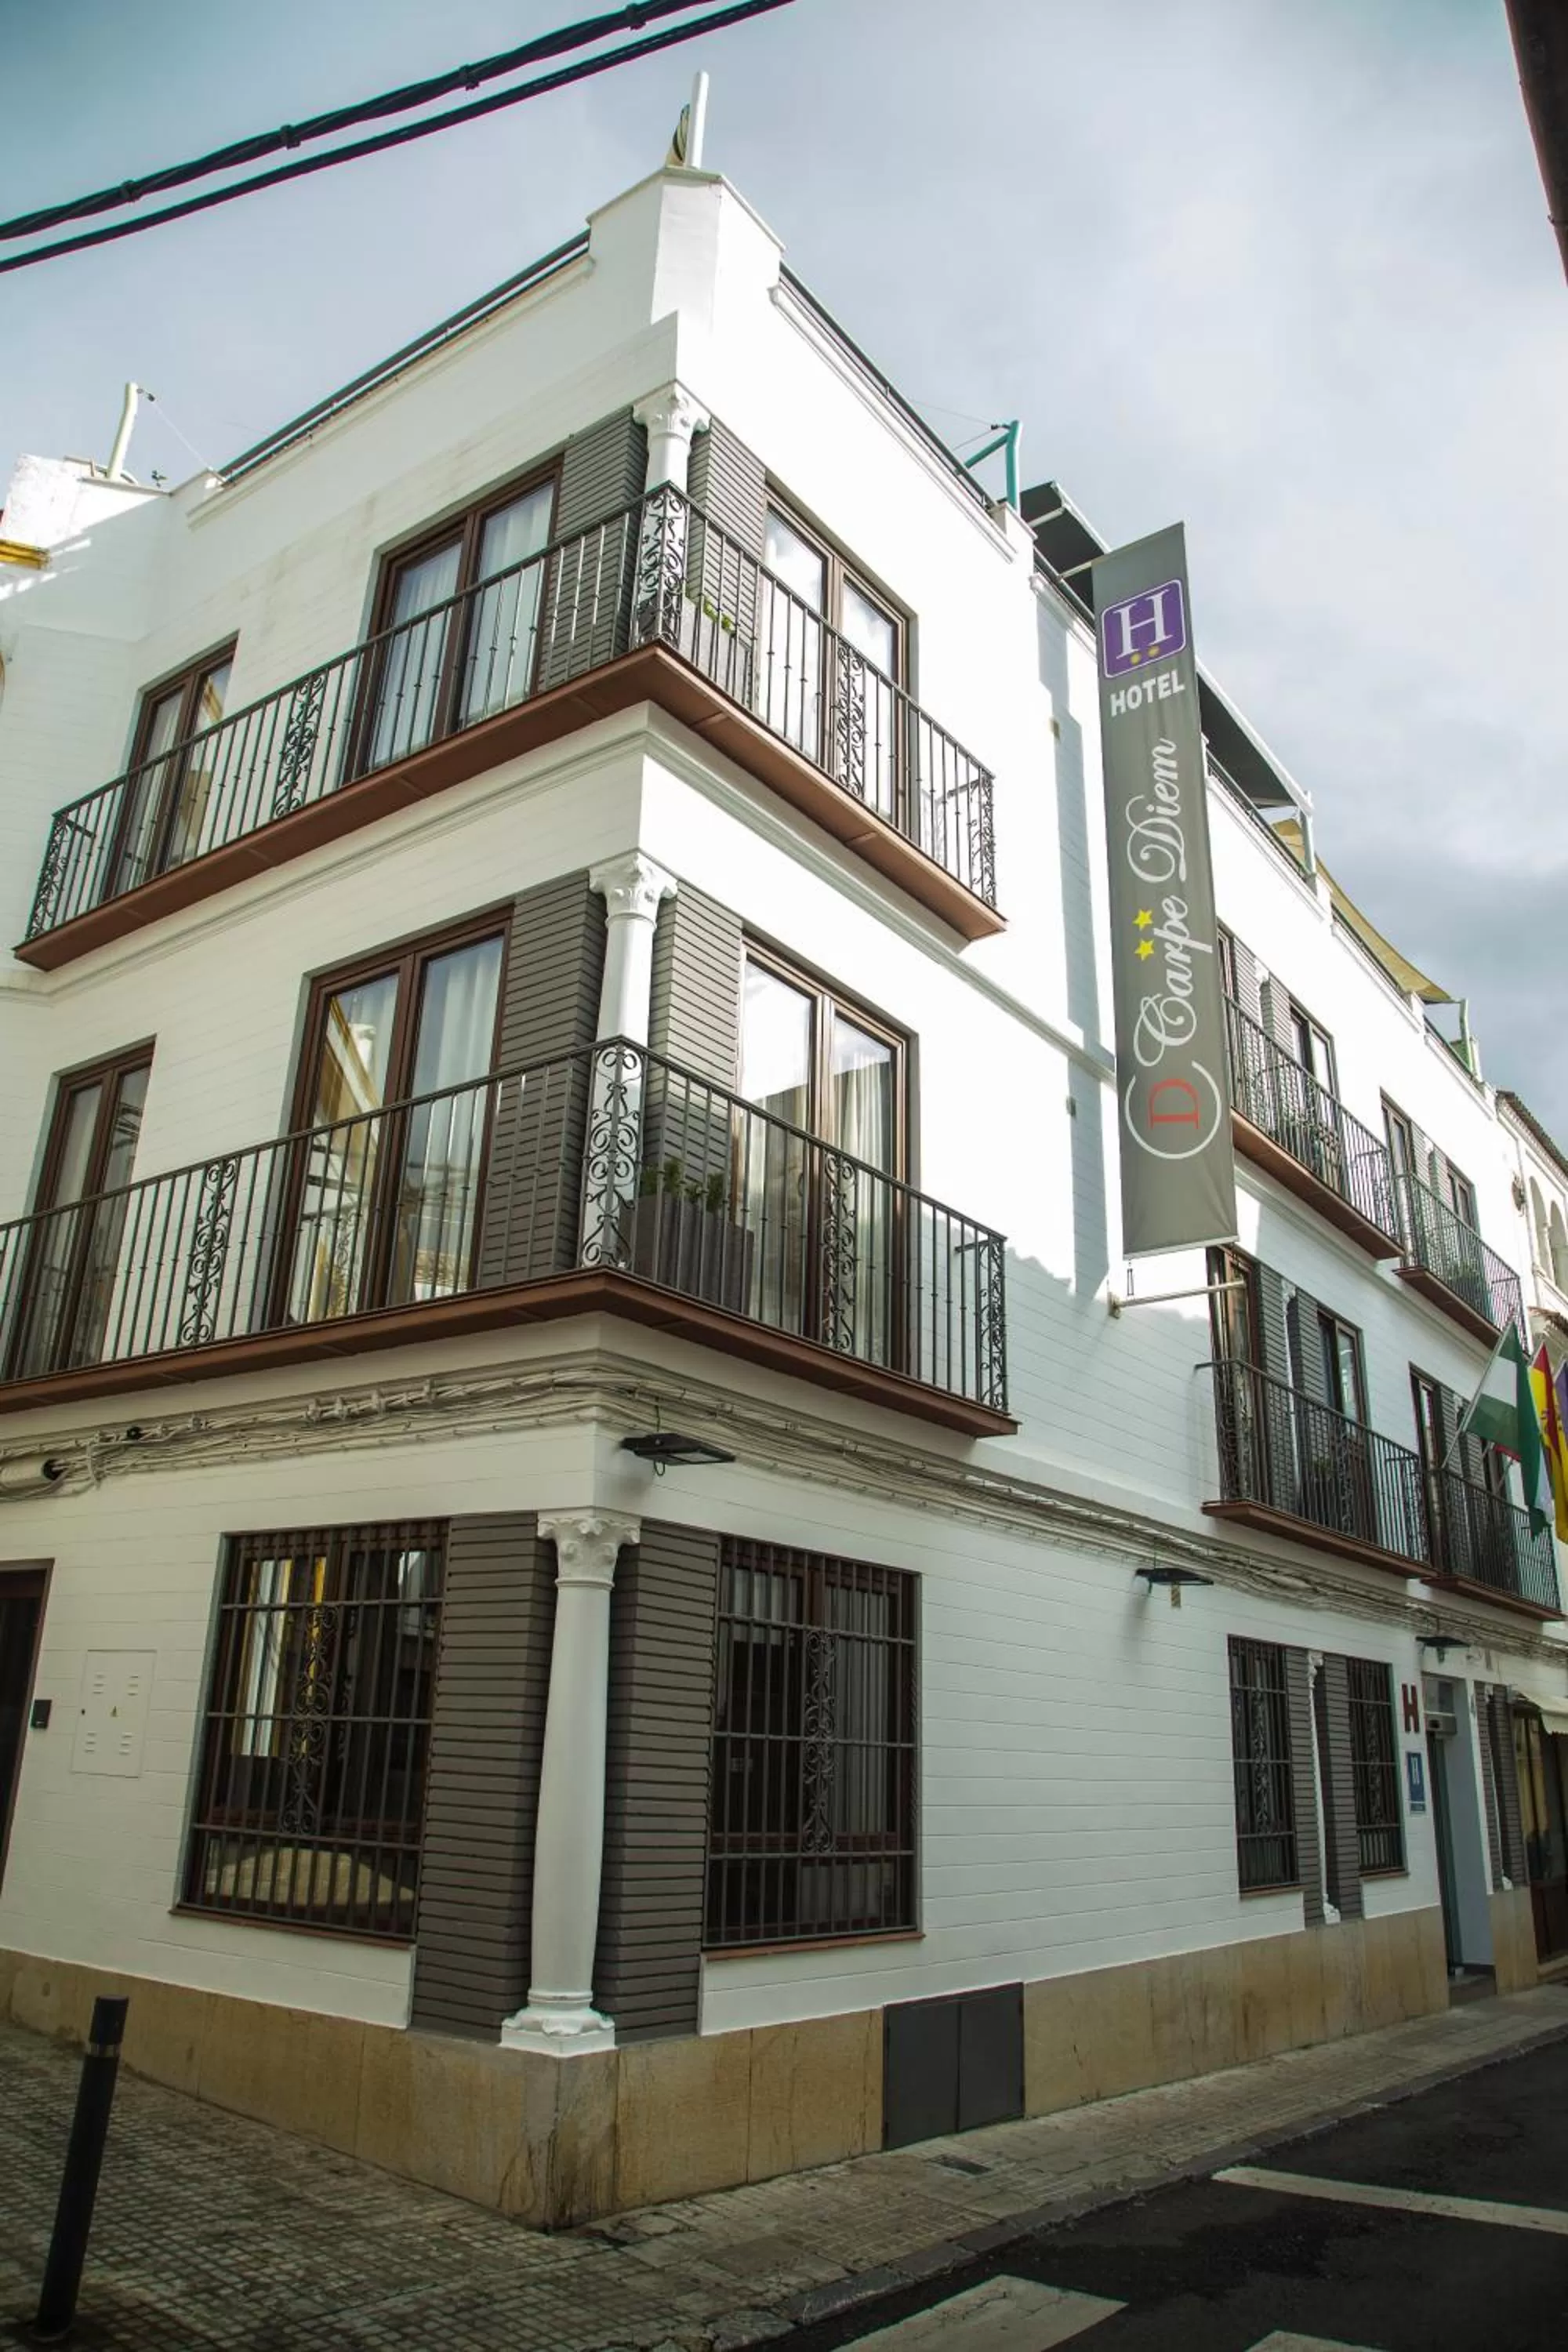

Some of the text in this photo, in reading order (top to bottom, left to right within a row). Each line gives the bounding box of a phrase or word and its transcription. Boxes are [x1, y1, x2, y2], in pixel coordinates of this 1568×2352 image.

[1112, 588, 1174, 660] H
[1109, 670, 1185, 717] HOTEL
[1126, 737, 1214, 1067] Carpe Diem
[1401, 1683, 1420, 1733] H
